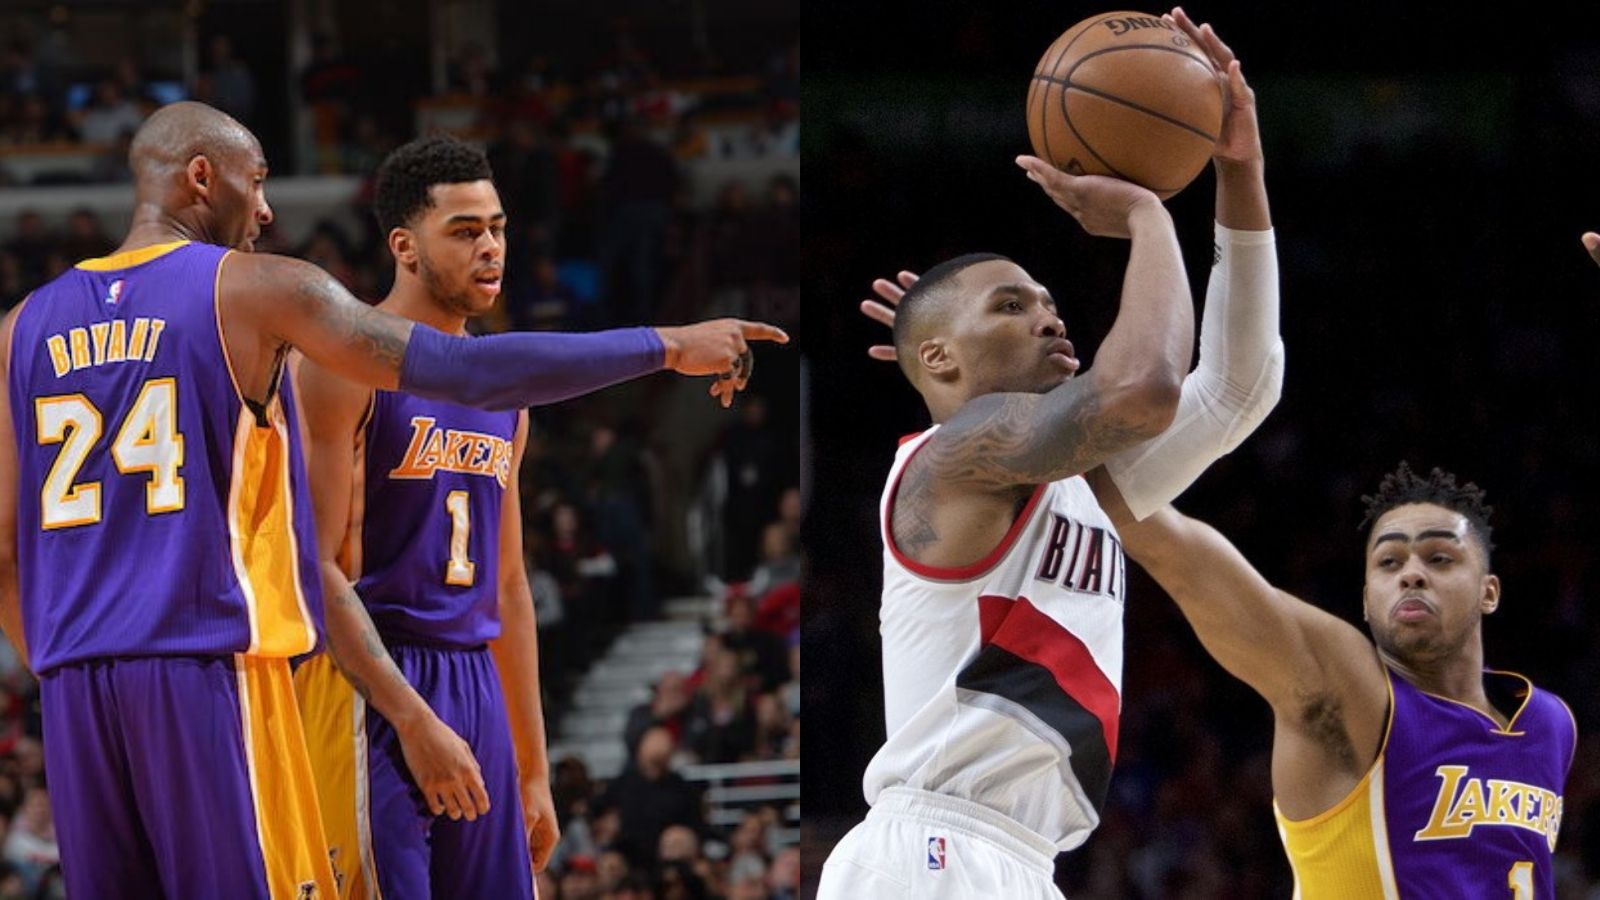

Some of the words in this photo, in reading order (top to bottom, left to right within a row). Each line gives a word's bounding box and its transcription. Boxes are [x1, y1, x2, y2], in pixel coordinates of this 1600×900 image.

[47, 317, 165, 378] BRYANT
[34, 377, 185, 531] 24
[388, 416, 513, 490] LAKERS
[445, 490, 476, 587] 1
[1413, 765, 1564, 854] LAKERS
